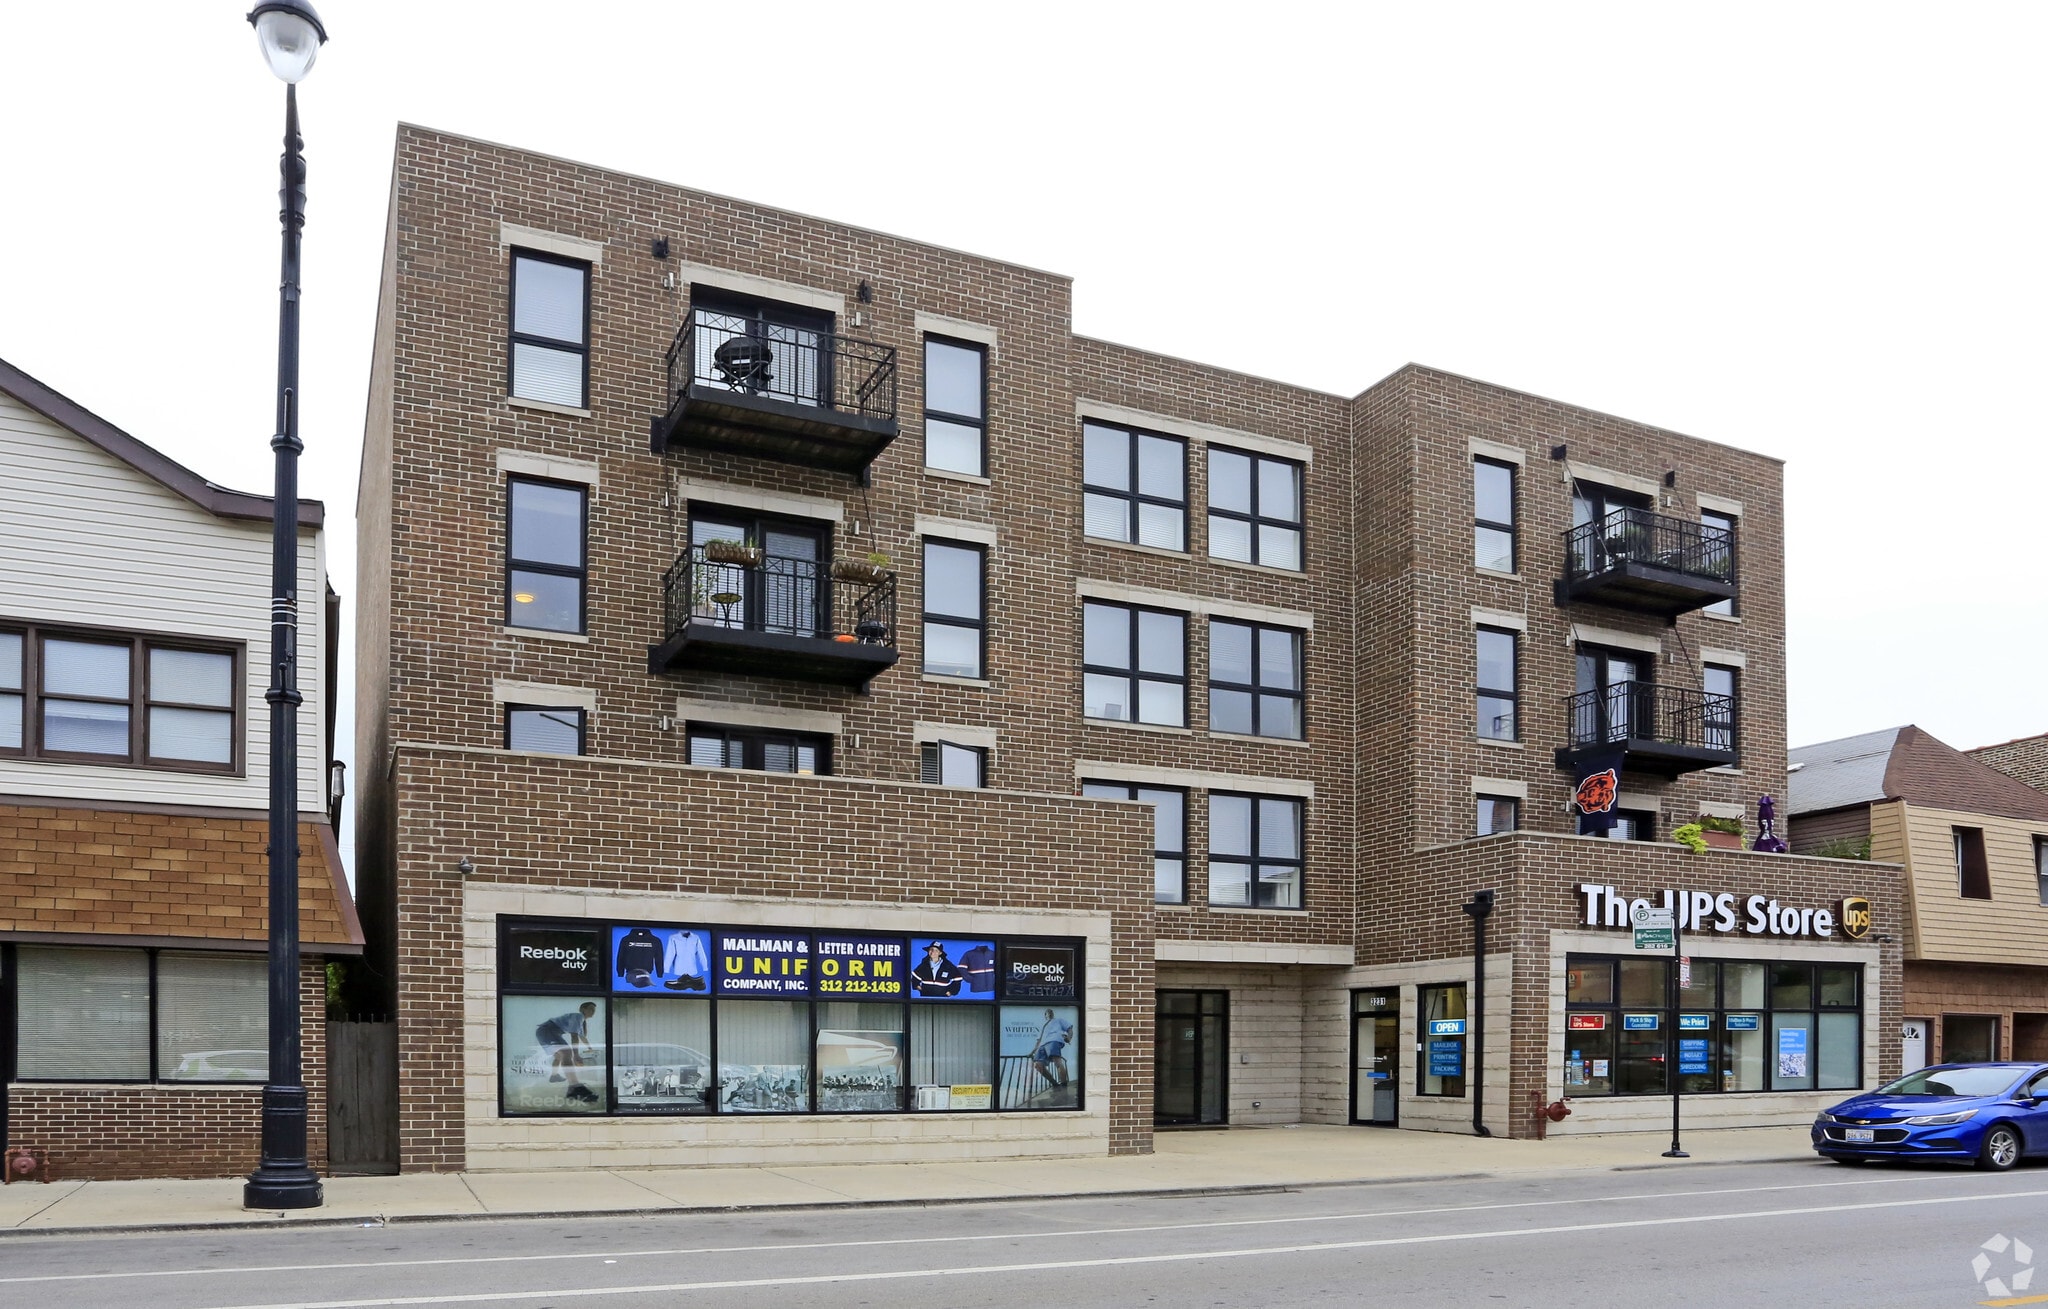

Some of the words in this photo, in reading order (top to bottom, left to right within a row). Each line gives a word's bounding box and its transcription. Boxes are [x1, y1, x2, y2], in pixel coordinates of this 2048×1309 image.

[1746, 895, 1833, 936] Store
[1845, 909, 1869, 932] ups
[520, 946, 587, 960] Reebok
[723, 938, 793, 953] MAILMAN
[796, 941, 809, 953] &
[818, 942, 854, 955] LETTER
[856, 943, 901, 957] CARRIER
[562, 960, 587, 971] duty
[1013, 962, 1065, 974] Reebok
[1044, 974, 1065, 983] duty
[723, 979, 782, 992] COMPANY,
[785, 980, 809, 991] INC.
[820, 980, 842, 991] 312
[845, 981, 901, 993] 212-1439
[1436, 1022, 1459, 1032] OPEN
[1680, 1018, 1690, 1026] We
[1691, 1018, 1705, 1026] Print
[520, 1095, 590, 1107] Reebok
